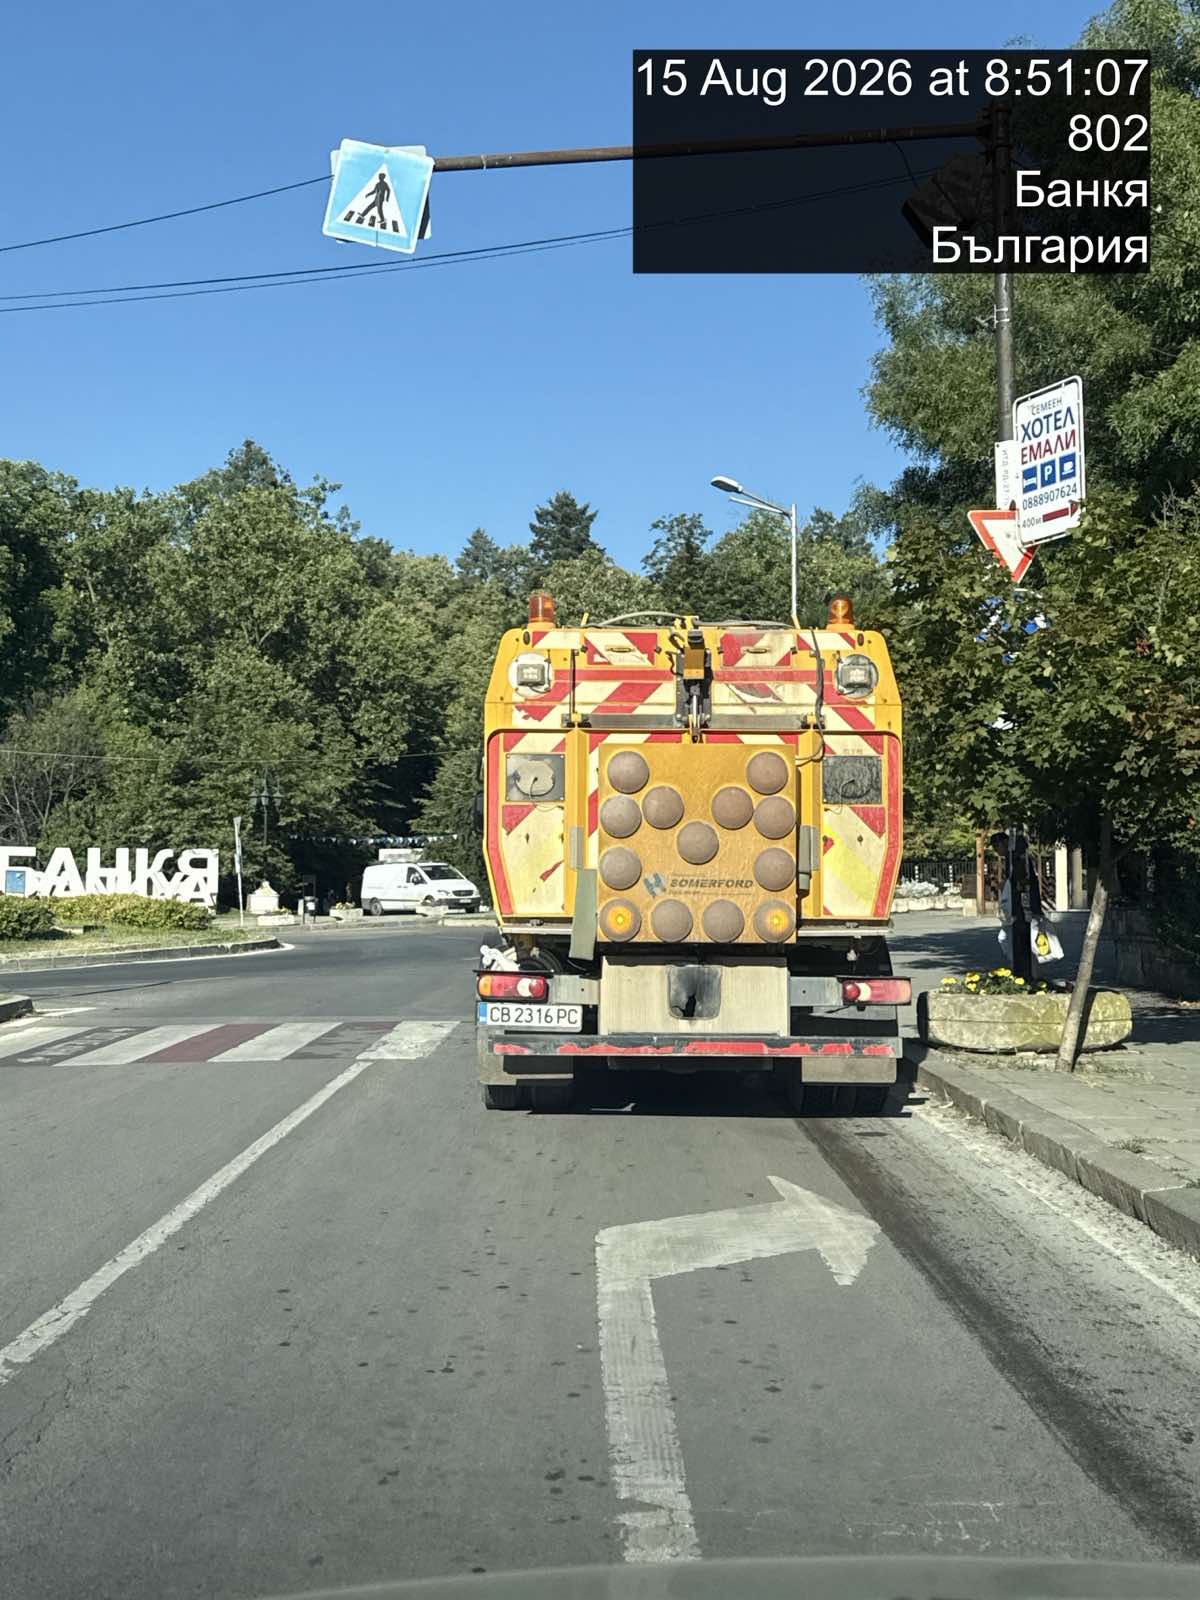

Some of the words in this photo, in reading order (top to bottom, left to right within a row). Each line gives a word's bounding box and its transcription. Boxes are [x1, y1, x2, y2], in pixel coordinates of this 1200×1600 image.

[1031, 396, 1062, 415] СЕМЕЕН
[1021, 406, 1075, 443] ХОТЕЛ
[1021, 429, 1076, 465] ЕМАЛИ
[1044, 465, 1052, 481] P
[1022, 482, 1077, 510] 0888907624
[0, 846, 219, 898] БАНКЯ
[670, 878, 753, 889] SOMERFORD
[514, 1008, 553, 1024] 2316
